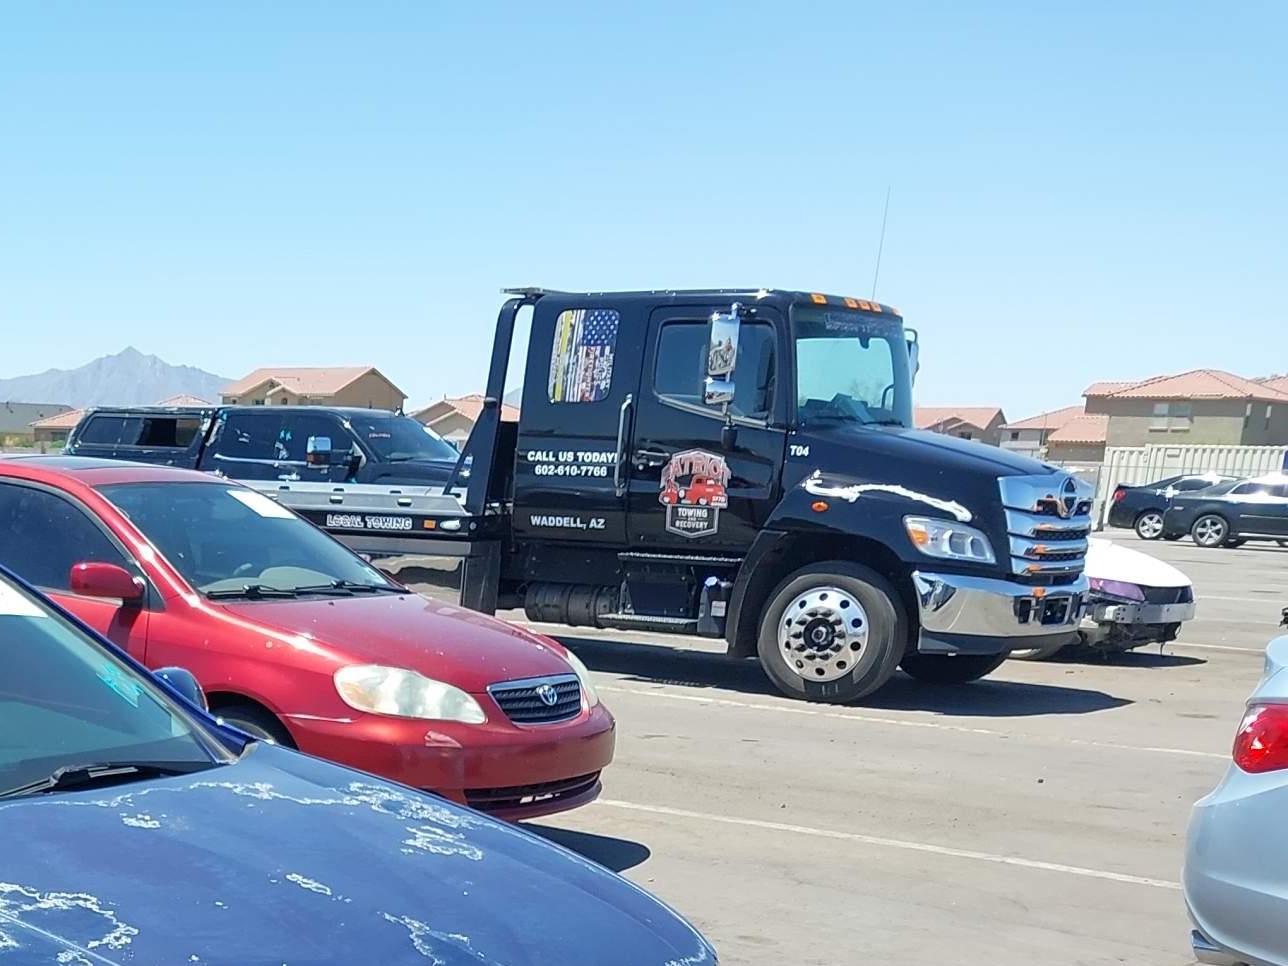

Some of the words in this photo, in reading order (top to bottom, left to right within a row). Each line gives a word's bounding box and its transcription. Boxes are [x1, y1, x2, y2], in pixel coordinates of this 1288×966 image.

[527, 451, 556, 462] CALL
[558, 451, 574, 462] US
[677, 507, 708, 518] TOWING
[365, 515, 413, 530] TOWING
[530, 515, 587, 530] WADDELL,
[588, 518, 606, 529] AZ
[675, 520, 709, 529] RECOVERY
